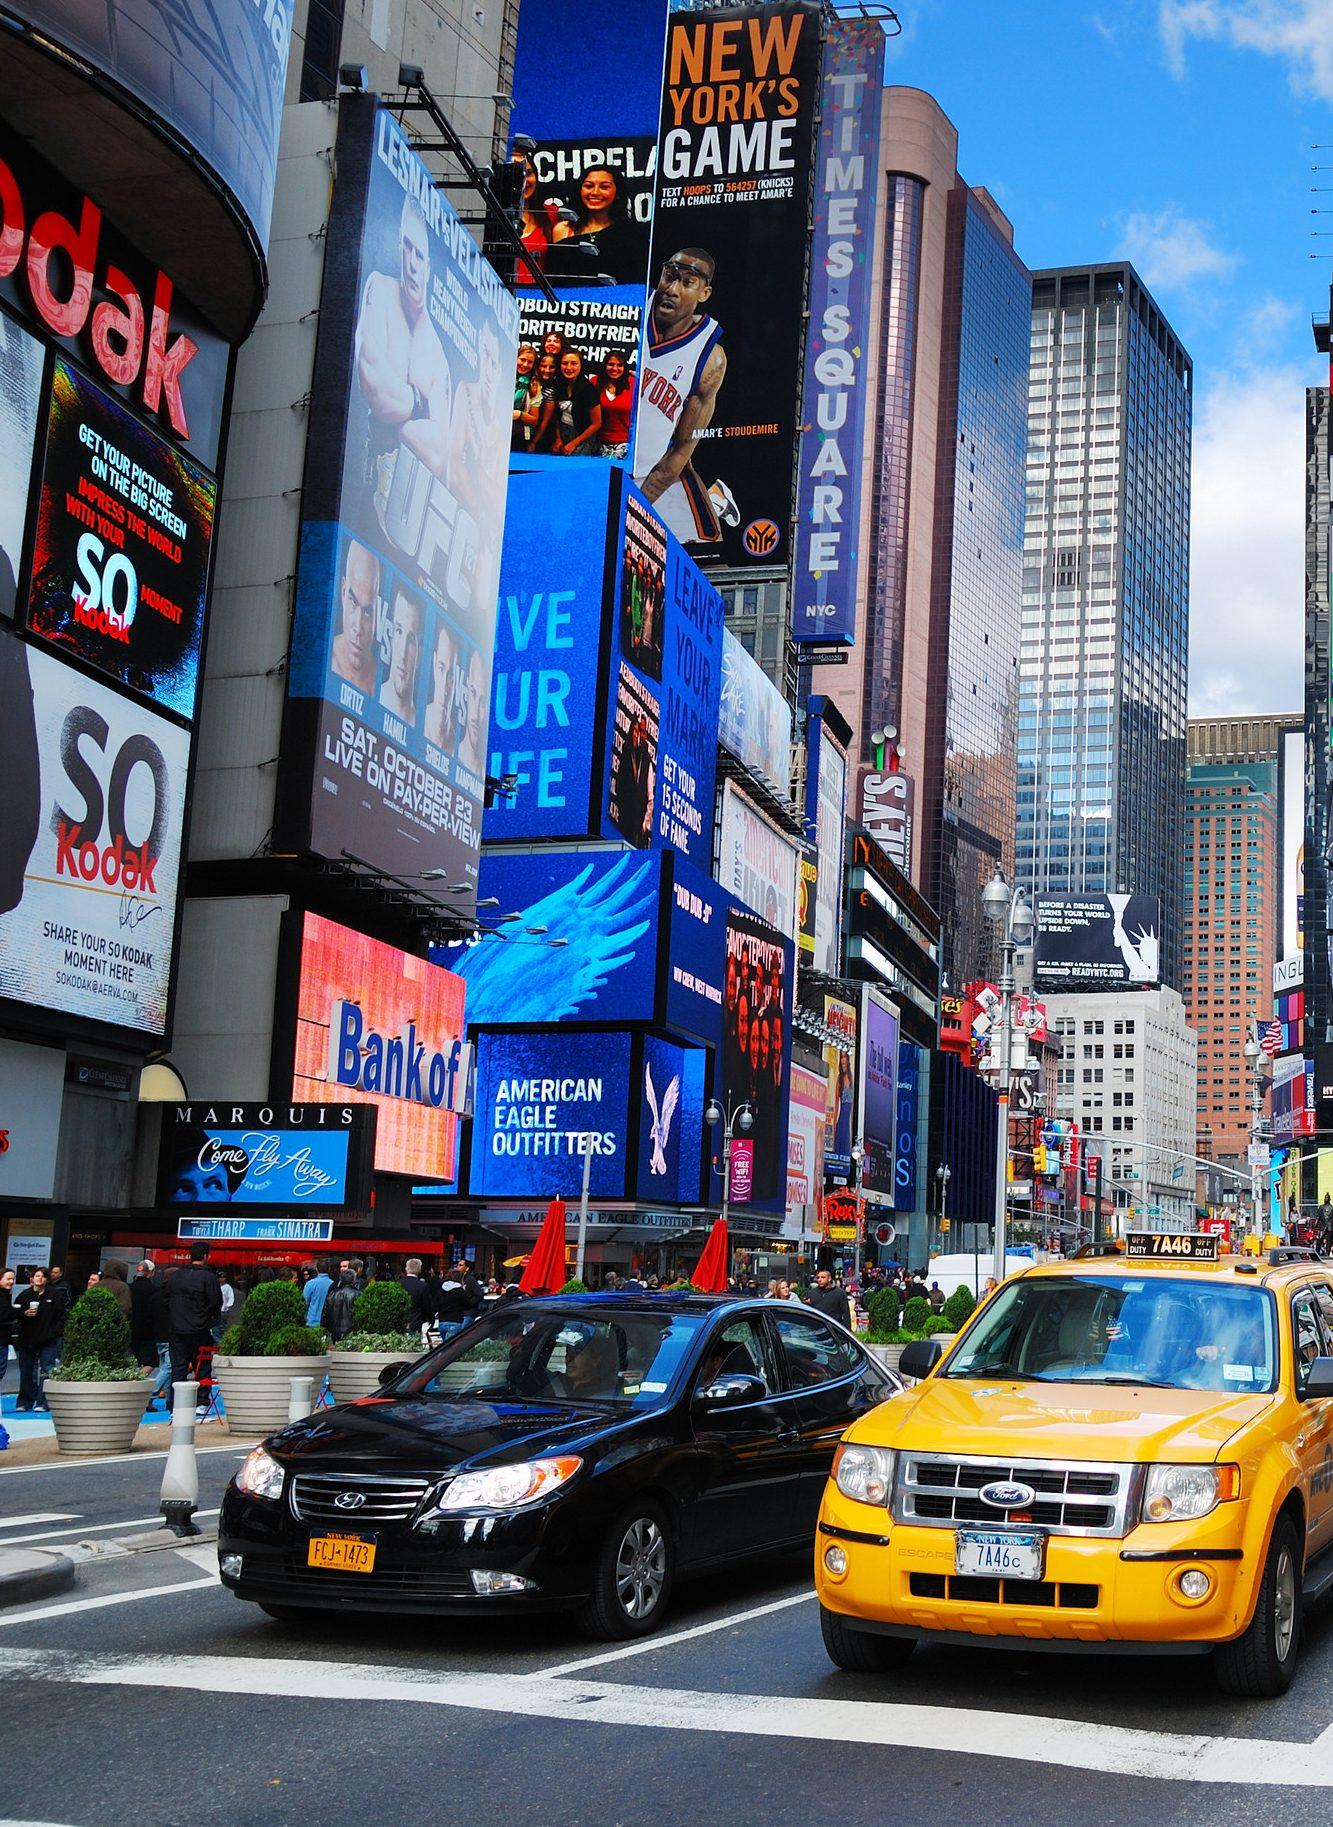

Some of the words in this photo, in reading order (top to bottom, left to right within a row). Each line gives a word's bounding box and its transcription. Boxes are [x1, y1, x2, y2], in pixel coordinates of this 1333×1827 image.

[669, 13, 804, 85] NEW
[669, 77, 801, 126] YORK'S
[662, 118, 798, 180] GAME
[661, 198, 678, 208] FOR
[679, 196, 686, 207] A
[687, 194, 721, 206] CHANCE
[723, 193, 734, 203] TO
[736, 190, 759, 202] MEET
[760, 188, 793, 200] AMAR'E
[662, 187, 682, 198] TEXT
[684, 184, 712, 196] HOOPS
[714, 183, 725, 194] TO
[726, 180, 756, 192] 564257
[757, 177, 794, 191] (KNICKS)
[824, 73, 869, 280] TIMES
[377, 111, 442, 235] LESNAR
[449, 217, 521, 345] VELASQUEZ
[692, 427, 723, 439] AMAR'E
[724, 423, 779, 437] STOUDEMIRE
[808, 303, 856, 571] SQUARE
[78, 423, 103, 453] GET
[103, 438, 131, 476] YOUR
[132, 462, 173, 508] PICTURE
[66, 493, 97, 528] WITH
[98, 516, 125, 549] YOUR
[78, 477, 125, 525] IMPRESS
[126, 507, 147, 540] THE
[147, 526, 182, 565] WORLD
[91, 455, 107, 479] ON
[108, 466, 129, 496] THE
[130, 481, 148, 510] BIG
[149, 496, 187, 540] SCREEN
[385, 441, 481, 611] UFC
[71, 532, 138, 632] SO
[141, 584, 183, 625] MOMENT
[674, 556, 719, 646] LEAVE
[74, 594, 131, 645] Kodak
[805, 604, 837, 617] NYC
[340, 683, 364, 717] ORTIZ
[384, 713, 407, 747] HAMILL
[426, 744, 449, 776] SHIELDS
[50, 705, 170, 862] SO
[325, 734, 363, 779] LIVE
[367, 762, 391, 795] ON
[341, 718, 378, 759] SAT.
[384, 745, 452, 809] OCTOBER
[455, 794, 473, 823] 23
[663, 754, 677, 782] GET
[677, 761, 696, 802] YOUR
[660, 811, 670, 838] OF
[670, 820, 690, 855] FAME.
[662, 783, 671, 807] 15
[671, 790, 702, 836] SECONDS
[55, 820, 157, 894] Kodak
[1038, 901, 1064, 909] BEFORE
[1074, 902, 1105, 910] DISASTER
[1038, 909, 1062, 917] TURNS
[1084, 911, 1110, 919] WORLD
[43, 920, 79, 946] SHARE
[80, 932, 107, 954] YOUR
[108, 940, 121, 958] SO
[121, 944, 153, 970] KODAK
[64, 949, 108, 978] MOMENT
[108, 962, 134, 983] HERE
[1071, 967, 1124, 978] READYNYC.ORG
[328, 999, 422, 1103] Bank
[428, 1039, 462, 1110] of
[496, 1078, 602, 1104] AMERICAN
[1305, 1071, 1314, 1110] Travelex
[175, 1107, 354, 1125] MARQUIS
[495, 1105, 557, 1130] EAGLE
[197, 1137, 248, 1173] Come
[230, 1132, 284, 1177] Fly
[285, 1147, 338, 1198] Away
[492, 1132, 617, 1157] OUTFITTERS
[211, 1220, 246, 1238] THARP
[276, 1221, 321, 1239] SINATRA
[598, 1213, 640, 1225] EAGLE
[1129, 1245, 1147, 1256] DUTY
[1195, 1247, 1213, 1258] DUTY
[1131, 1236, 1146, 1246] OFF
[1151, 1235, 1191, 1255] 7A46
[1196, 1237, 1212, 1247] OFF
[993, 1487, 1018, 1501] Ford
[326, 1532, 343, 1541] NEW
[343, 1532, 362, 1542] YORK
[898, 1548, 954, 1561] ESCAPE
[978, 1535, 997, 1545] NEW
[999, 1536, 1021, 1546] YORK
